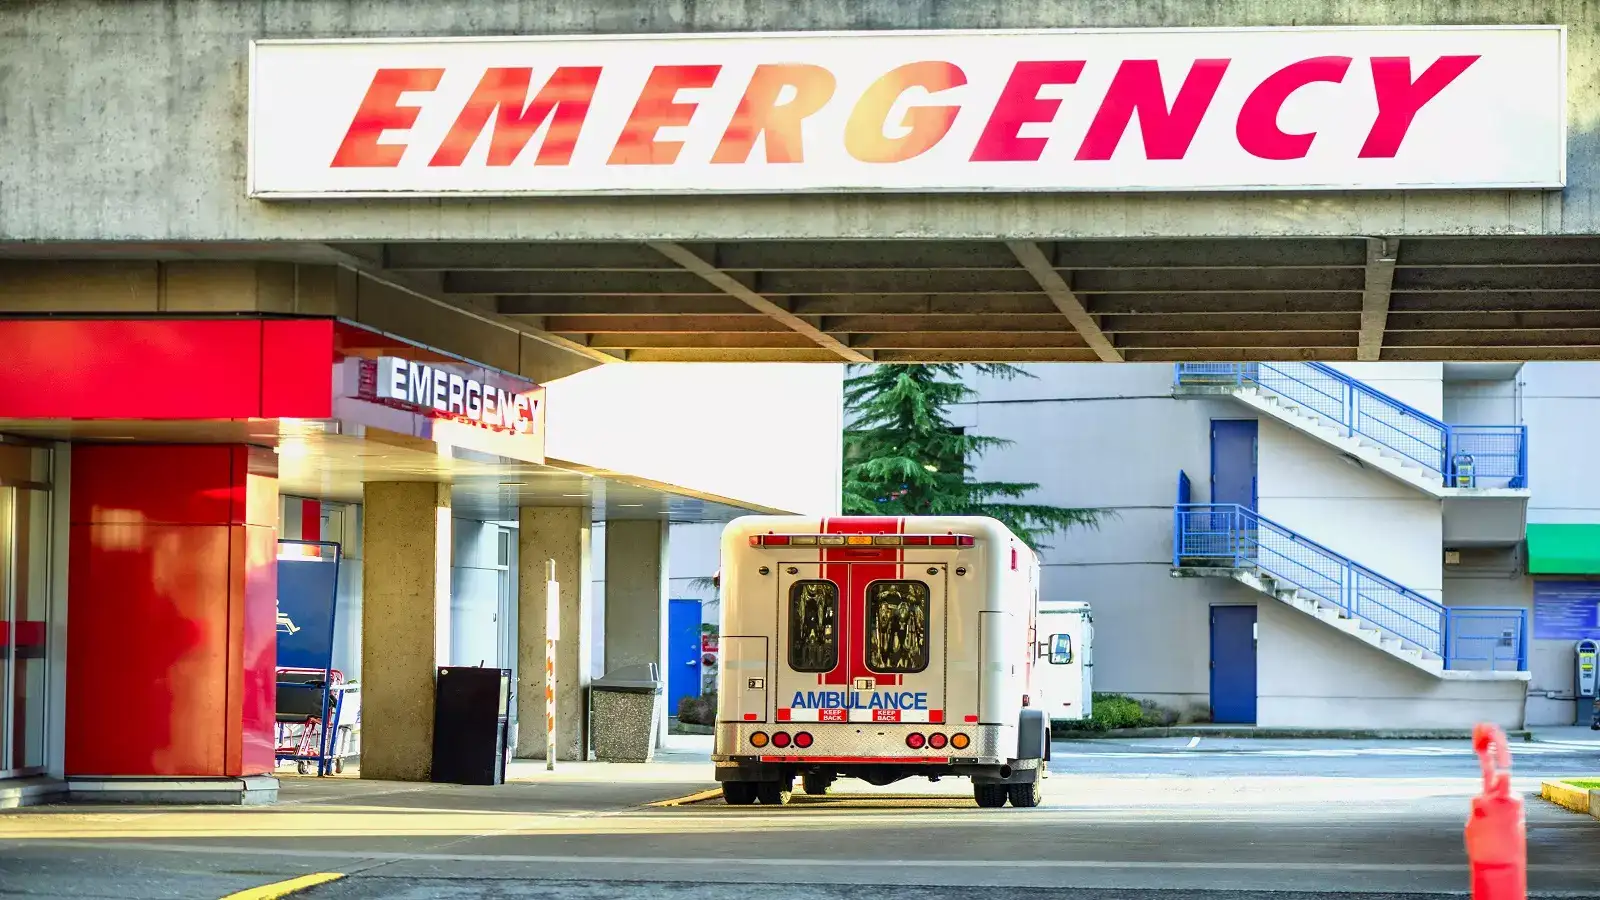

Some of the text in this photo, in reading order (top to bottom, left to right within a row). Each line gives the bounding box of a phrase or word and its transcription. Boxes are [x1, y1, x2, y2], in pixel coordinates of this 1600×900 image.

[330, 54, 1480, 167] EMERGENCY
[389, 356, 541, 435] EMERGENCY
[791, 691, 928, 710] AMBULANCE
